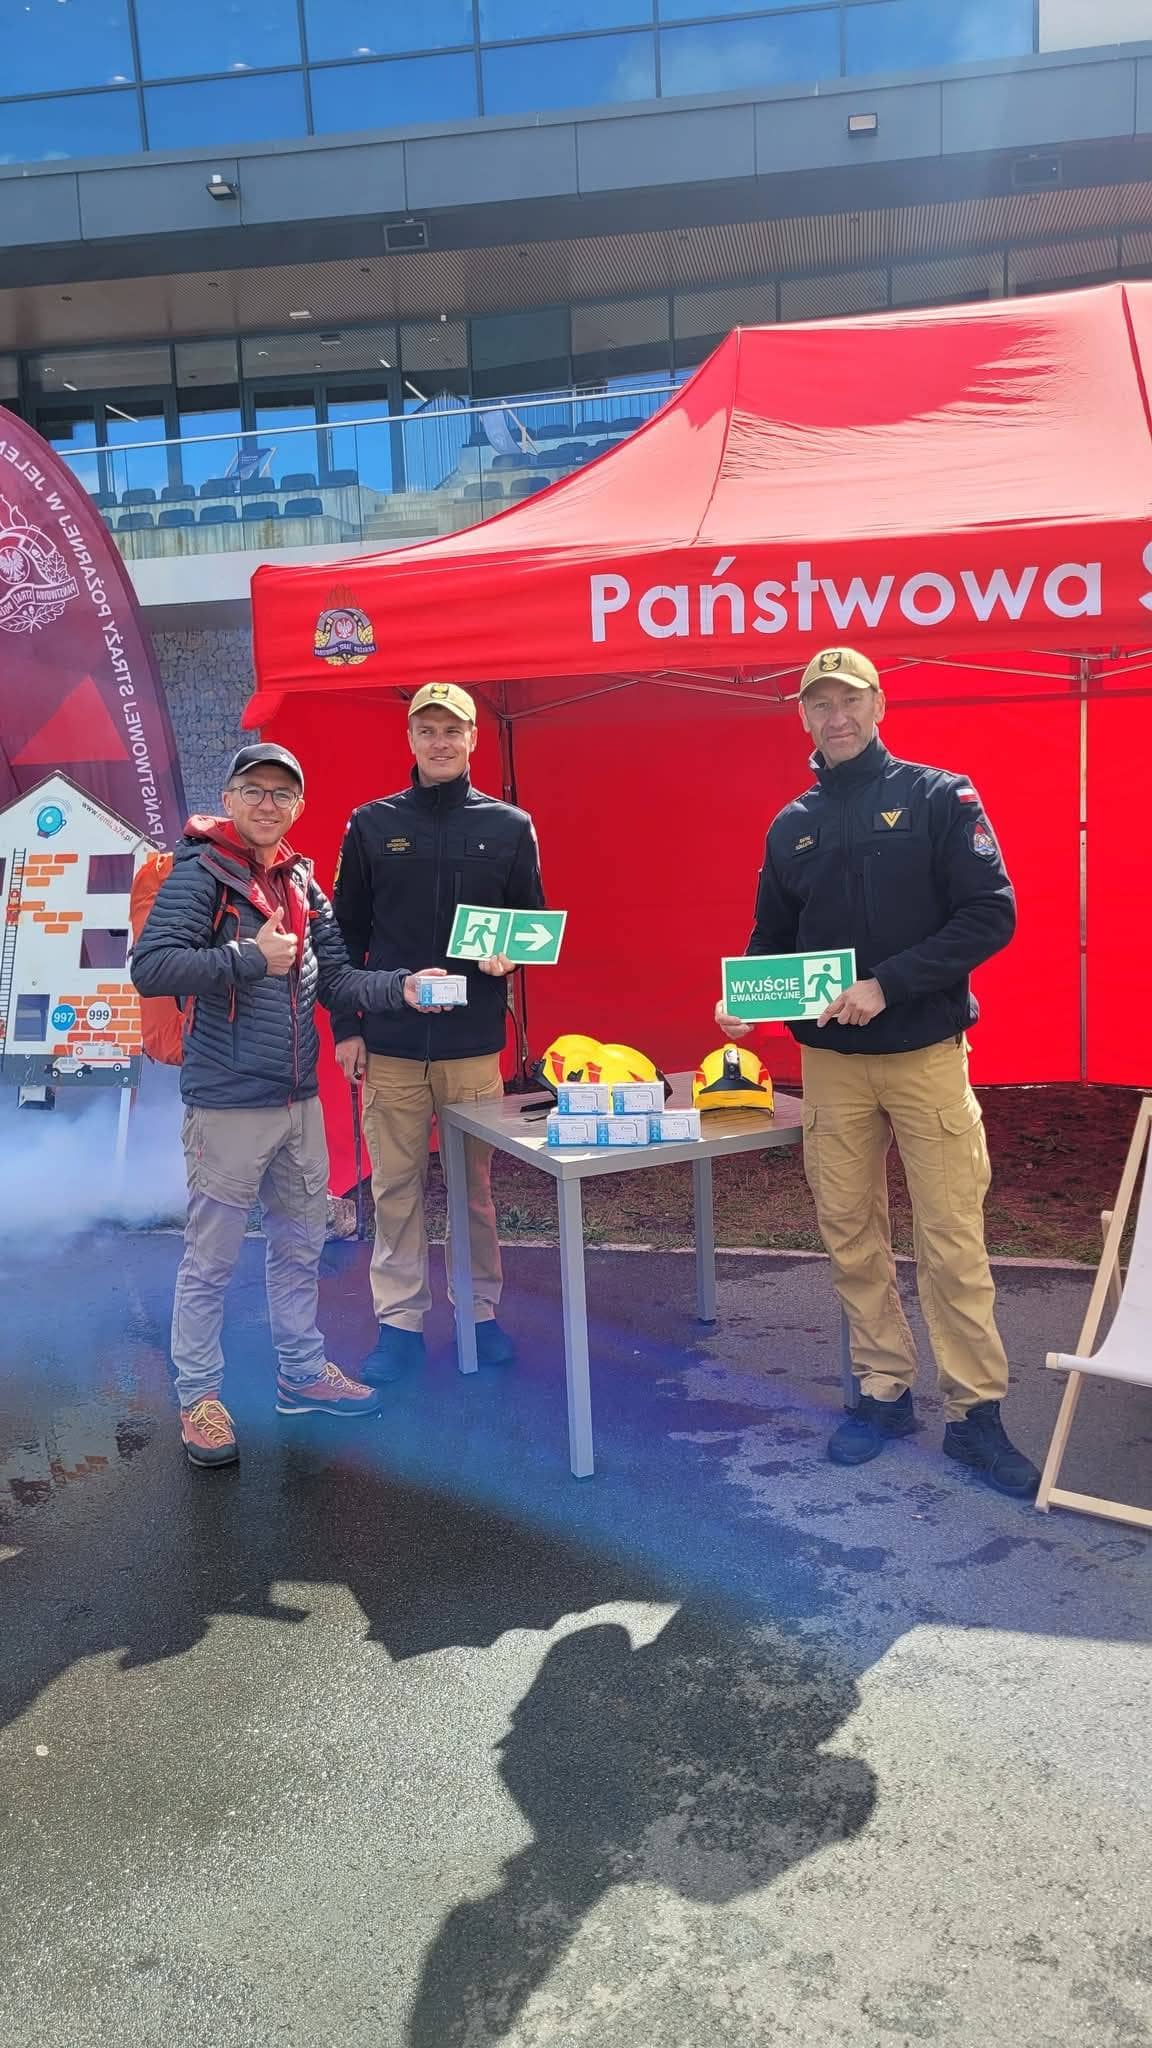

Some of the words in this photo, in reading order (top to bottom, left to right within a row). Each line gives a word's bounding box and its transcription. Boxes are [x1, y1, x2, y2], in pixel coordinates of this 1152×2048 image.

[589, 556, 1102, 642] Państwowa
[730, 976, 800, 993] WYJŚCIE
[730, 991, 801, 1002] EWAKUACYJNE
[53, 1012, 73, 1023] 997
[89, 1009, 110, 1021] 999
